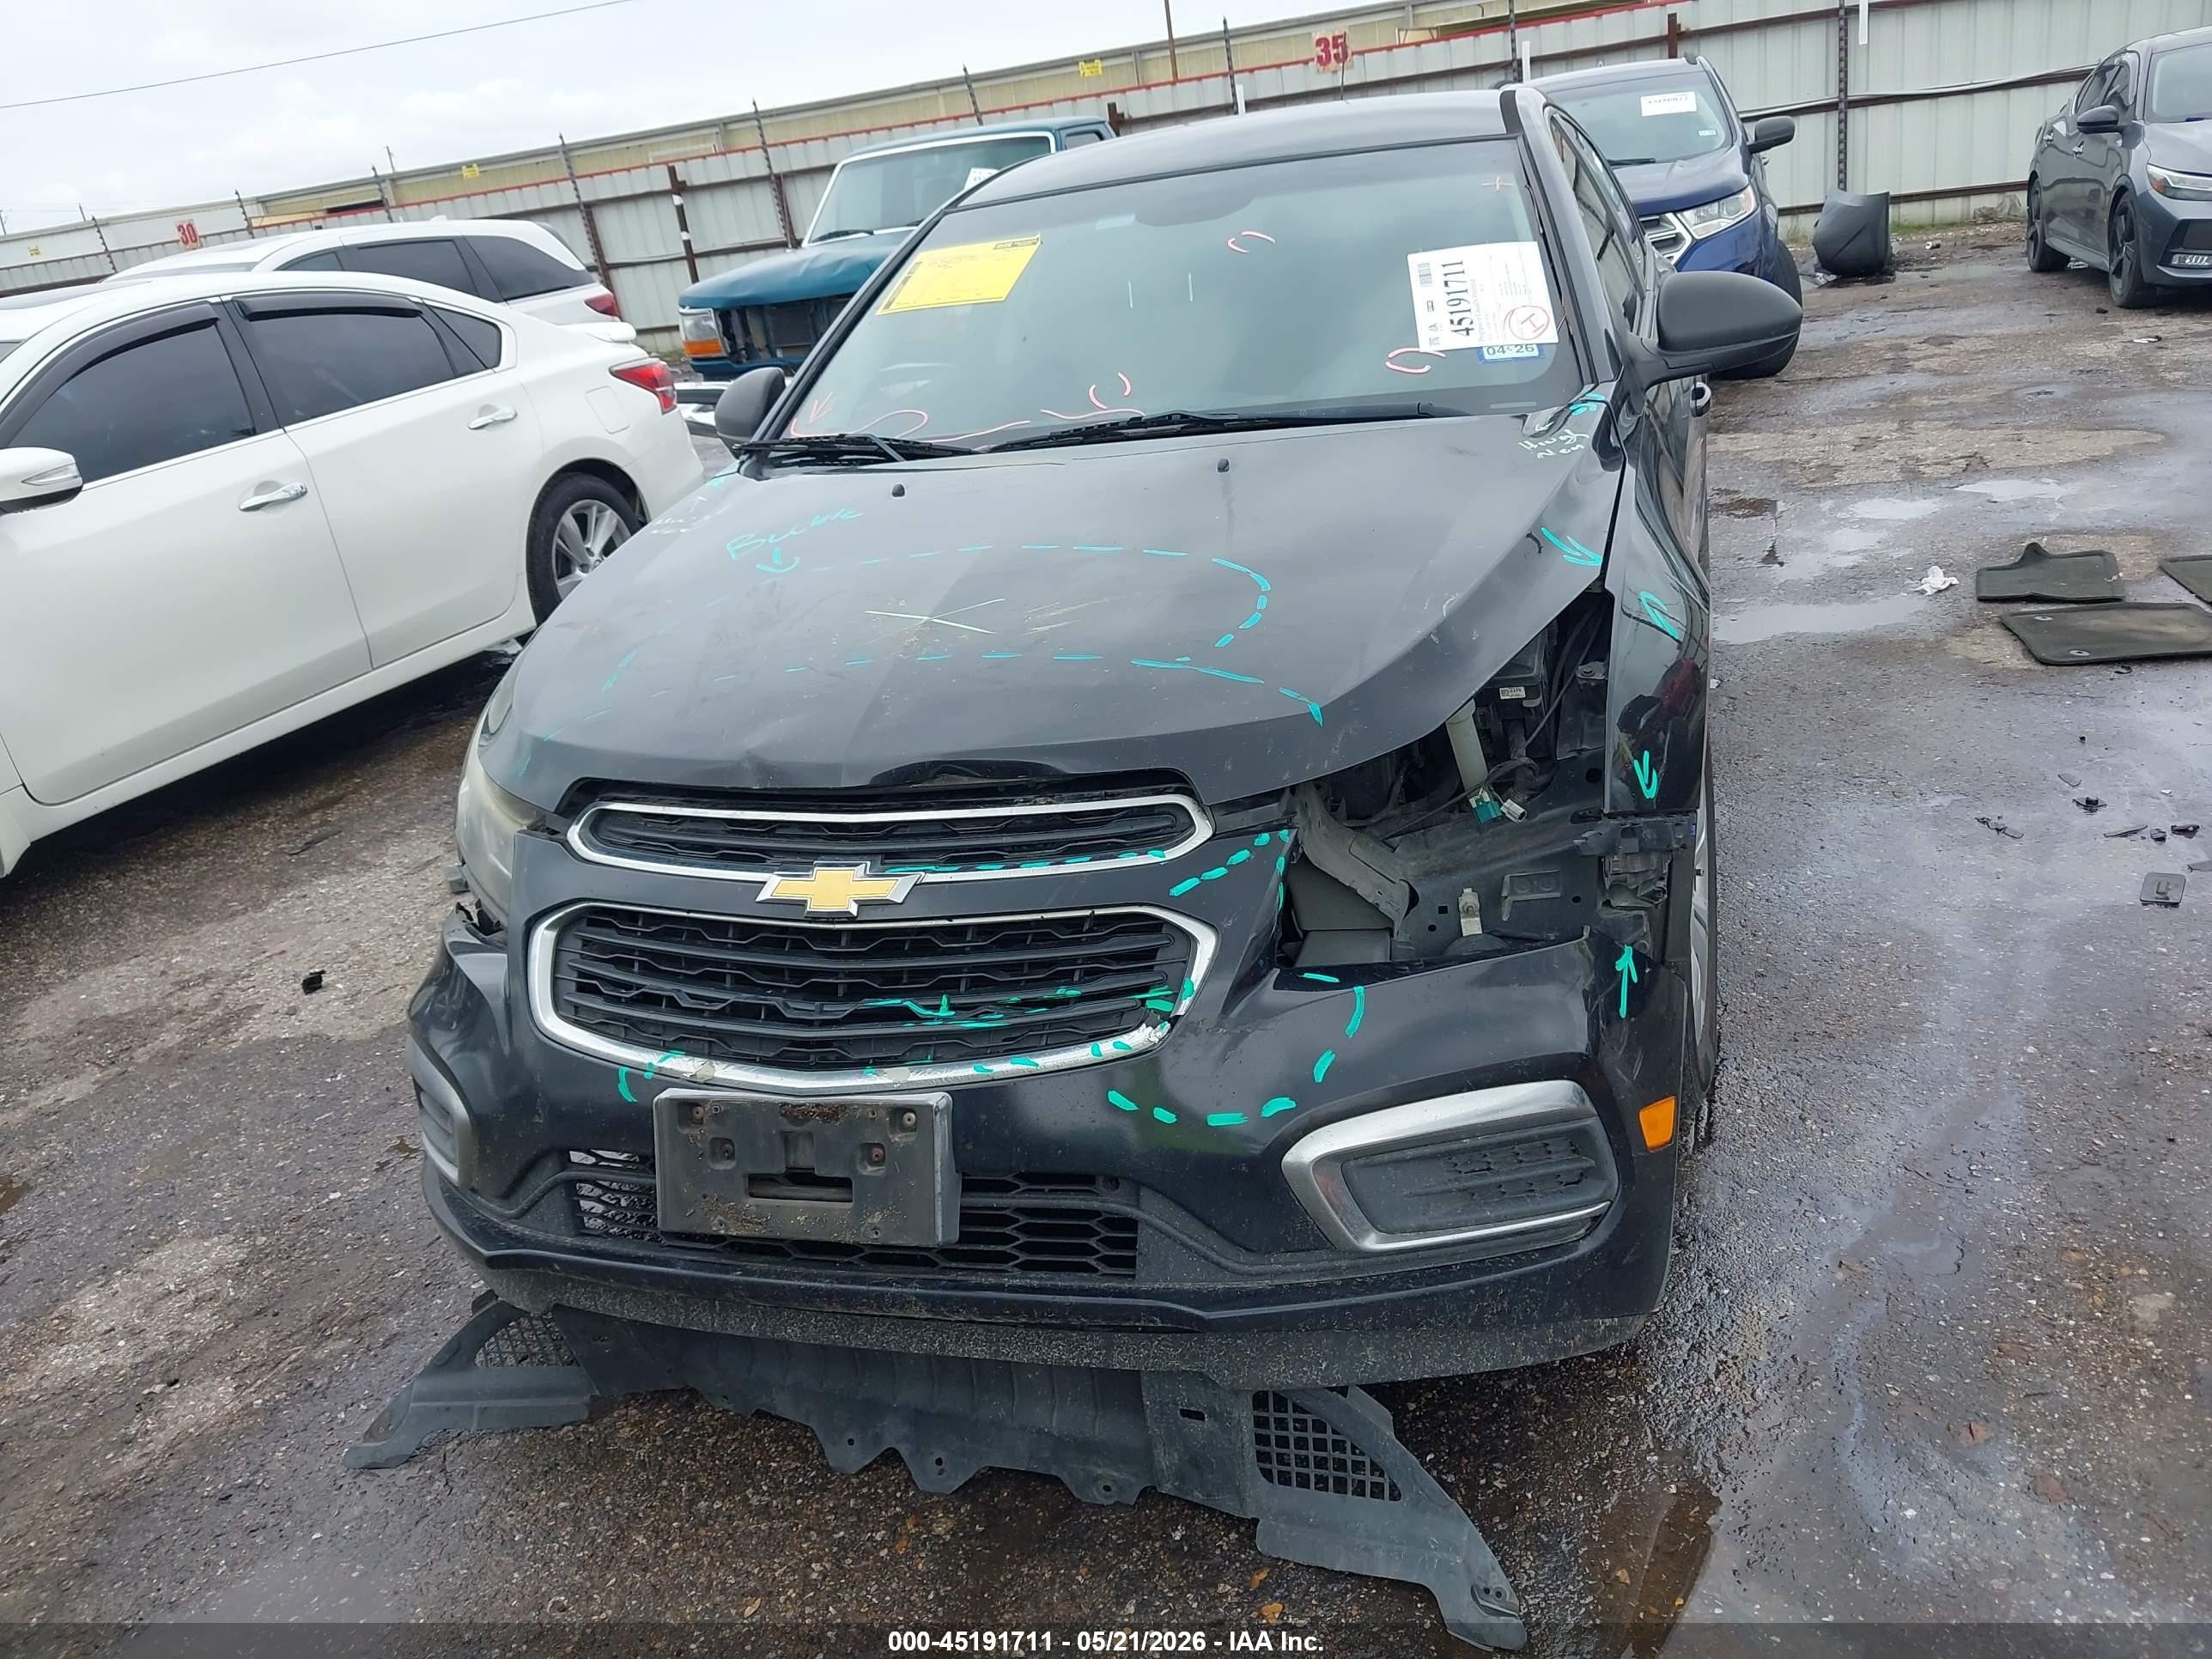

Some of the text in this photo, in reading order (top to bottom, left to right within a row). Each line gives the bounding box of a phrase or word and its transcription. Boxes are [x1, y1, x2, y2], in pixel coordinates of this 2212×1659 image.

[1316, 34, 1348, 66] 35
[178, 223, 198, 245] 30
[1441, 260, 1474, 337] 45191711
[1486, 343, 1535, 356] 04 26
